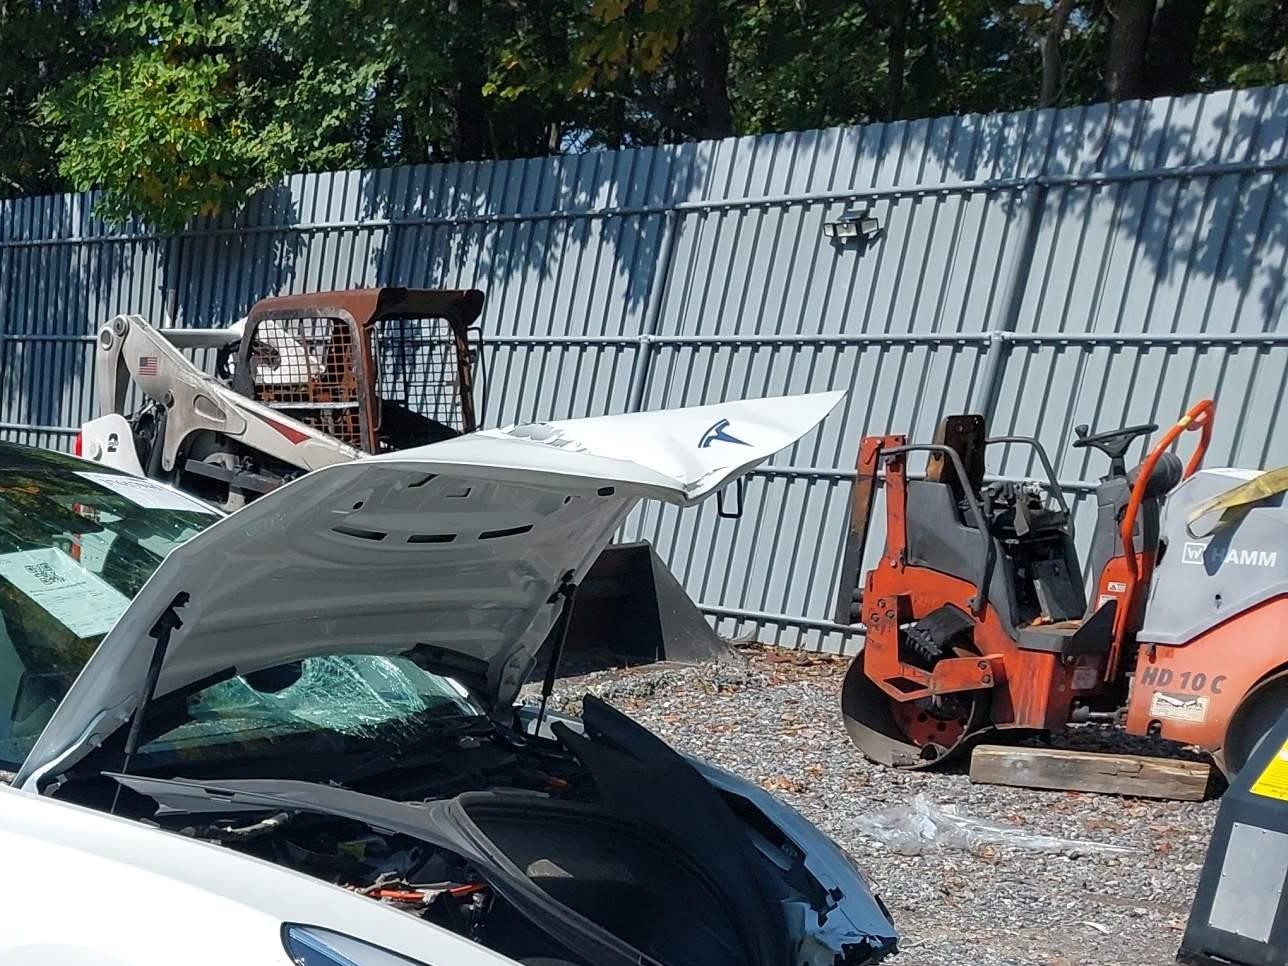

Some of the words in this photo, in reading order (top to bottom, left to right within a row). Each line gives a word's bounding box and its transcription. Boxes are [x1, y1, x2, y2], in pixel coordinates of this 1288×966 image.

[1212, 547, 1277, 567] HAMM
[1141, 666, 1173, 687] HD
[1180, 672, 1207, 691] 10
[1210, 675, 1227, 694] C
